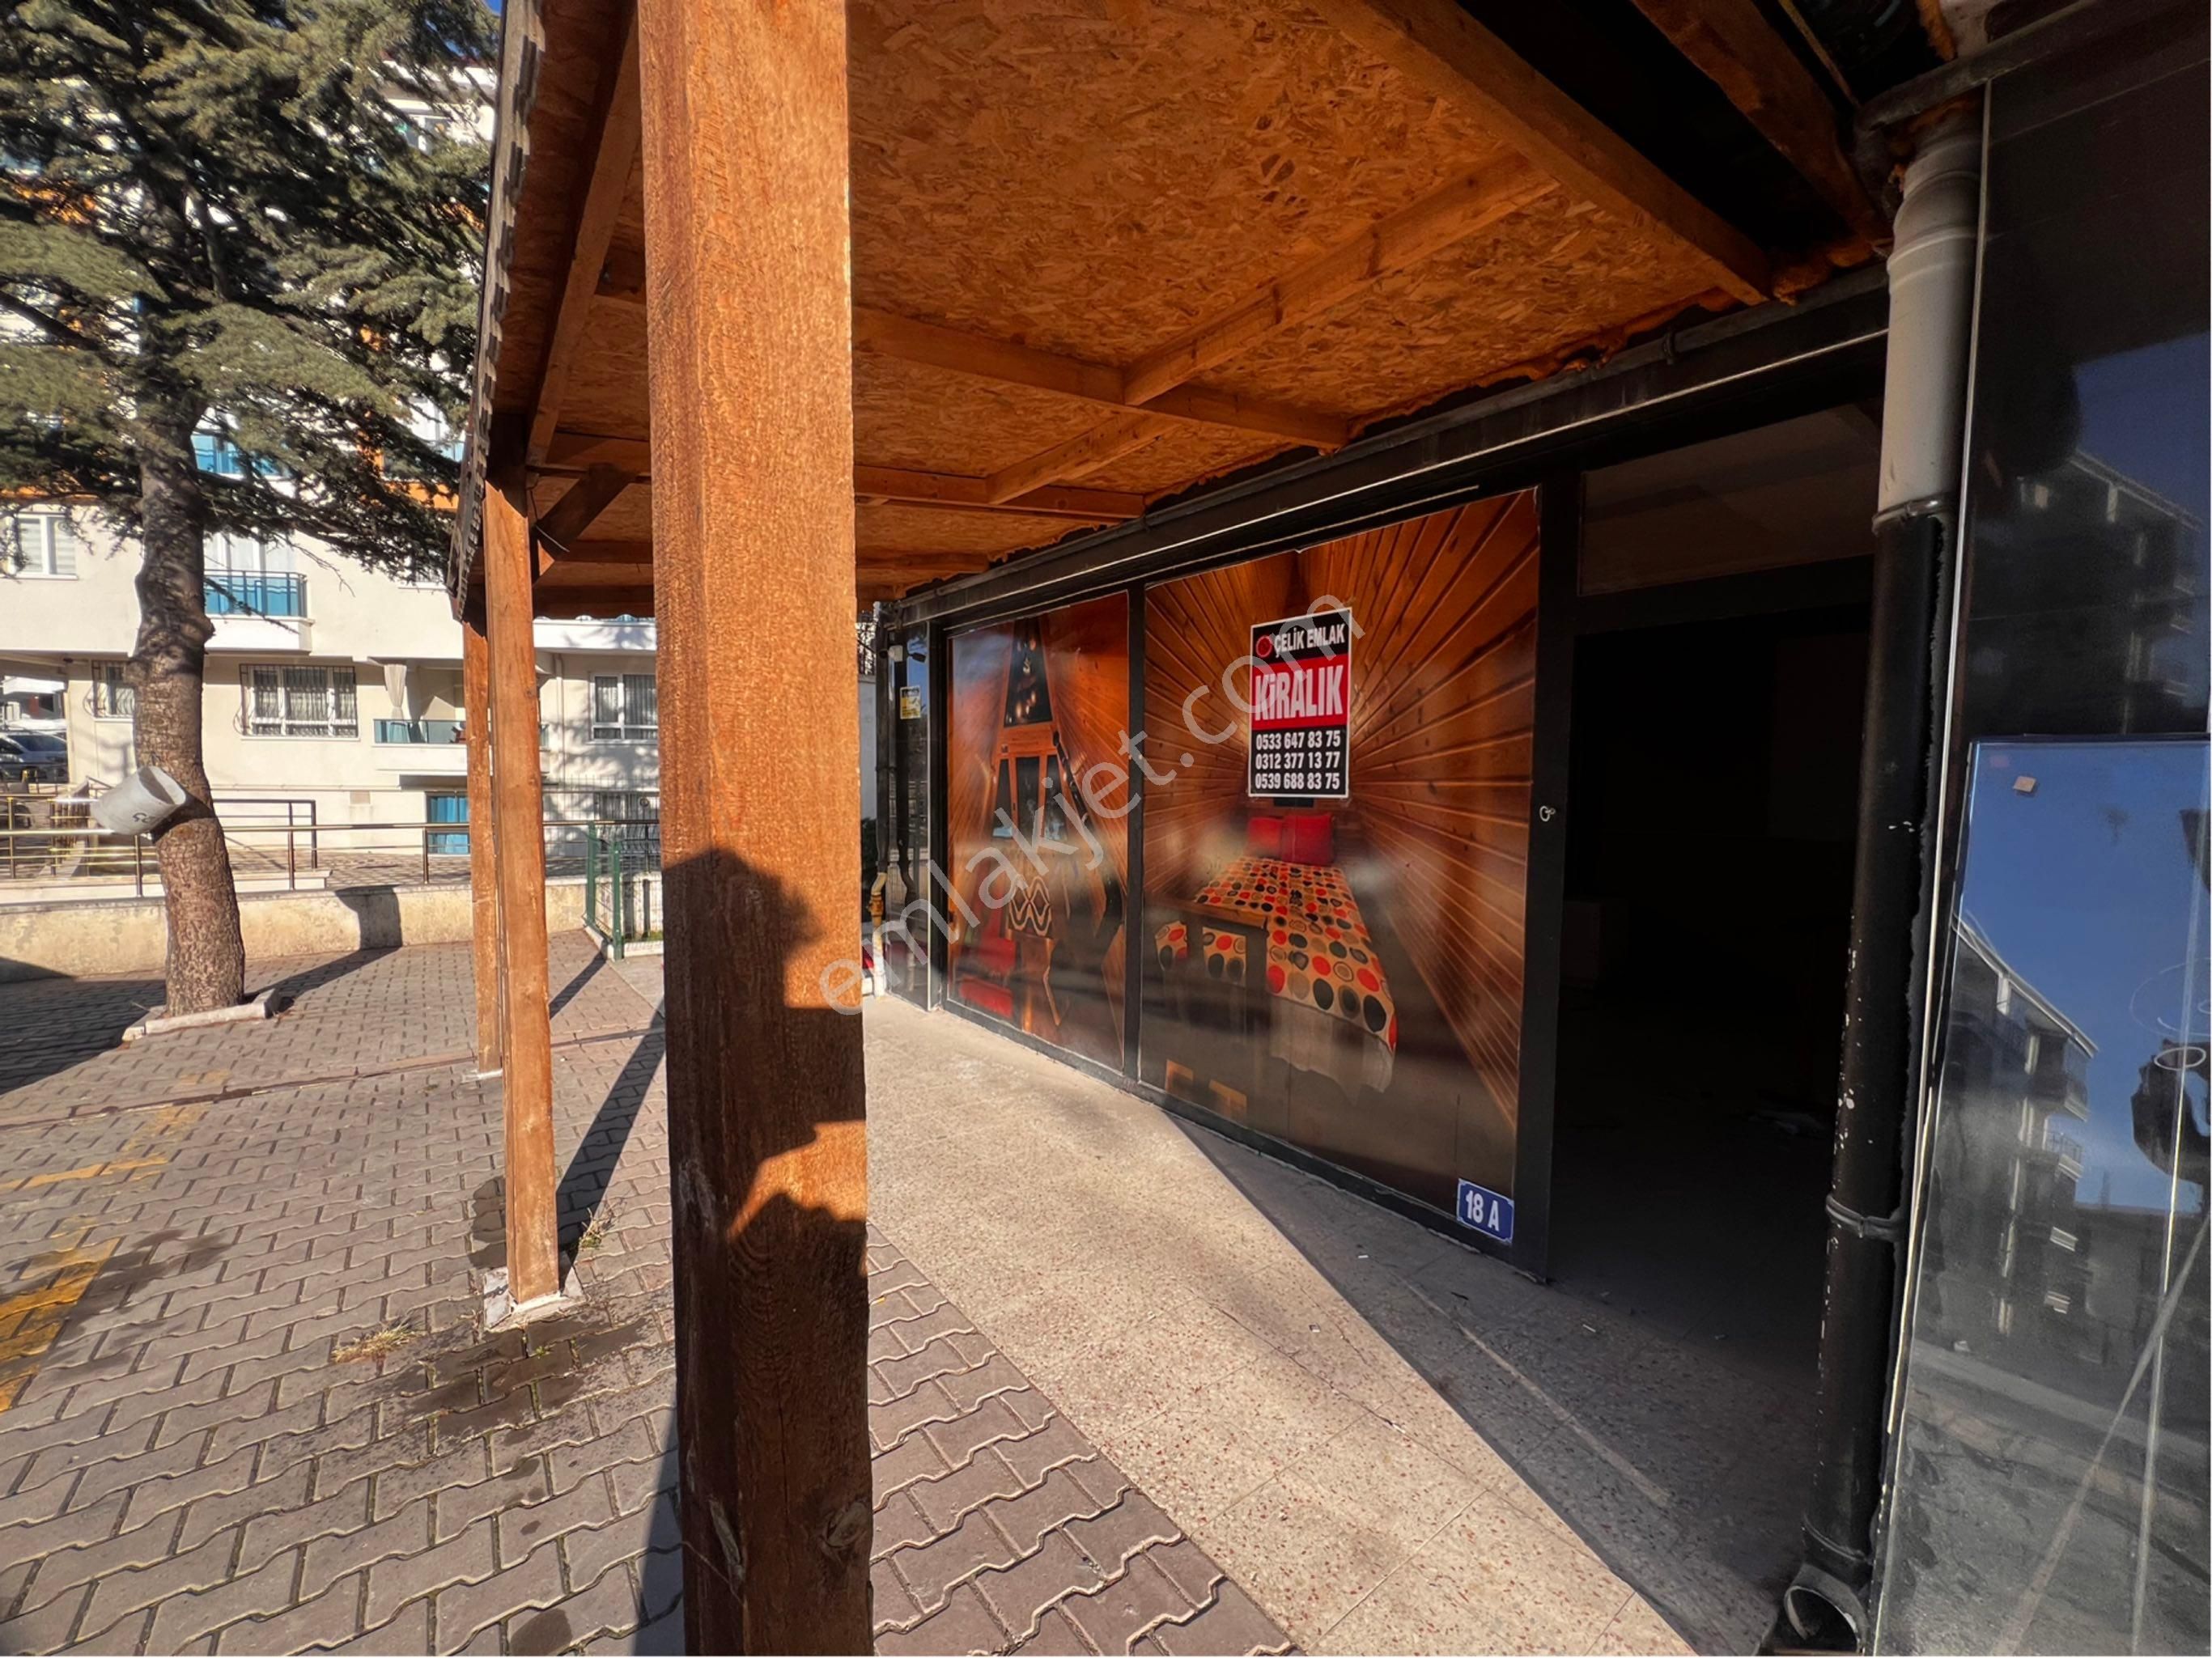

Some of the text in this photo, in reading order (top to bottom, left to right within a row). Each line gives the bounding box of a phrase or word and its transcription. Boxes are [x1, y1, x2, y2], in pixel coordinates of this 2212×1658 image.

[1274, 623, 1345, 659] ÇELİK EMLAK
[1255, 730, 1340, 751] 0533 647 83 75
[1255, 751, 1340, 770] 0312 377 13 77
[1255, 771, 1340, 790] 0539 688 83 75
[1465, 1189, 1500, 1232] 18 A
